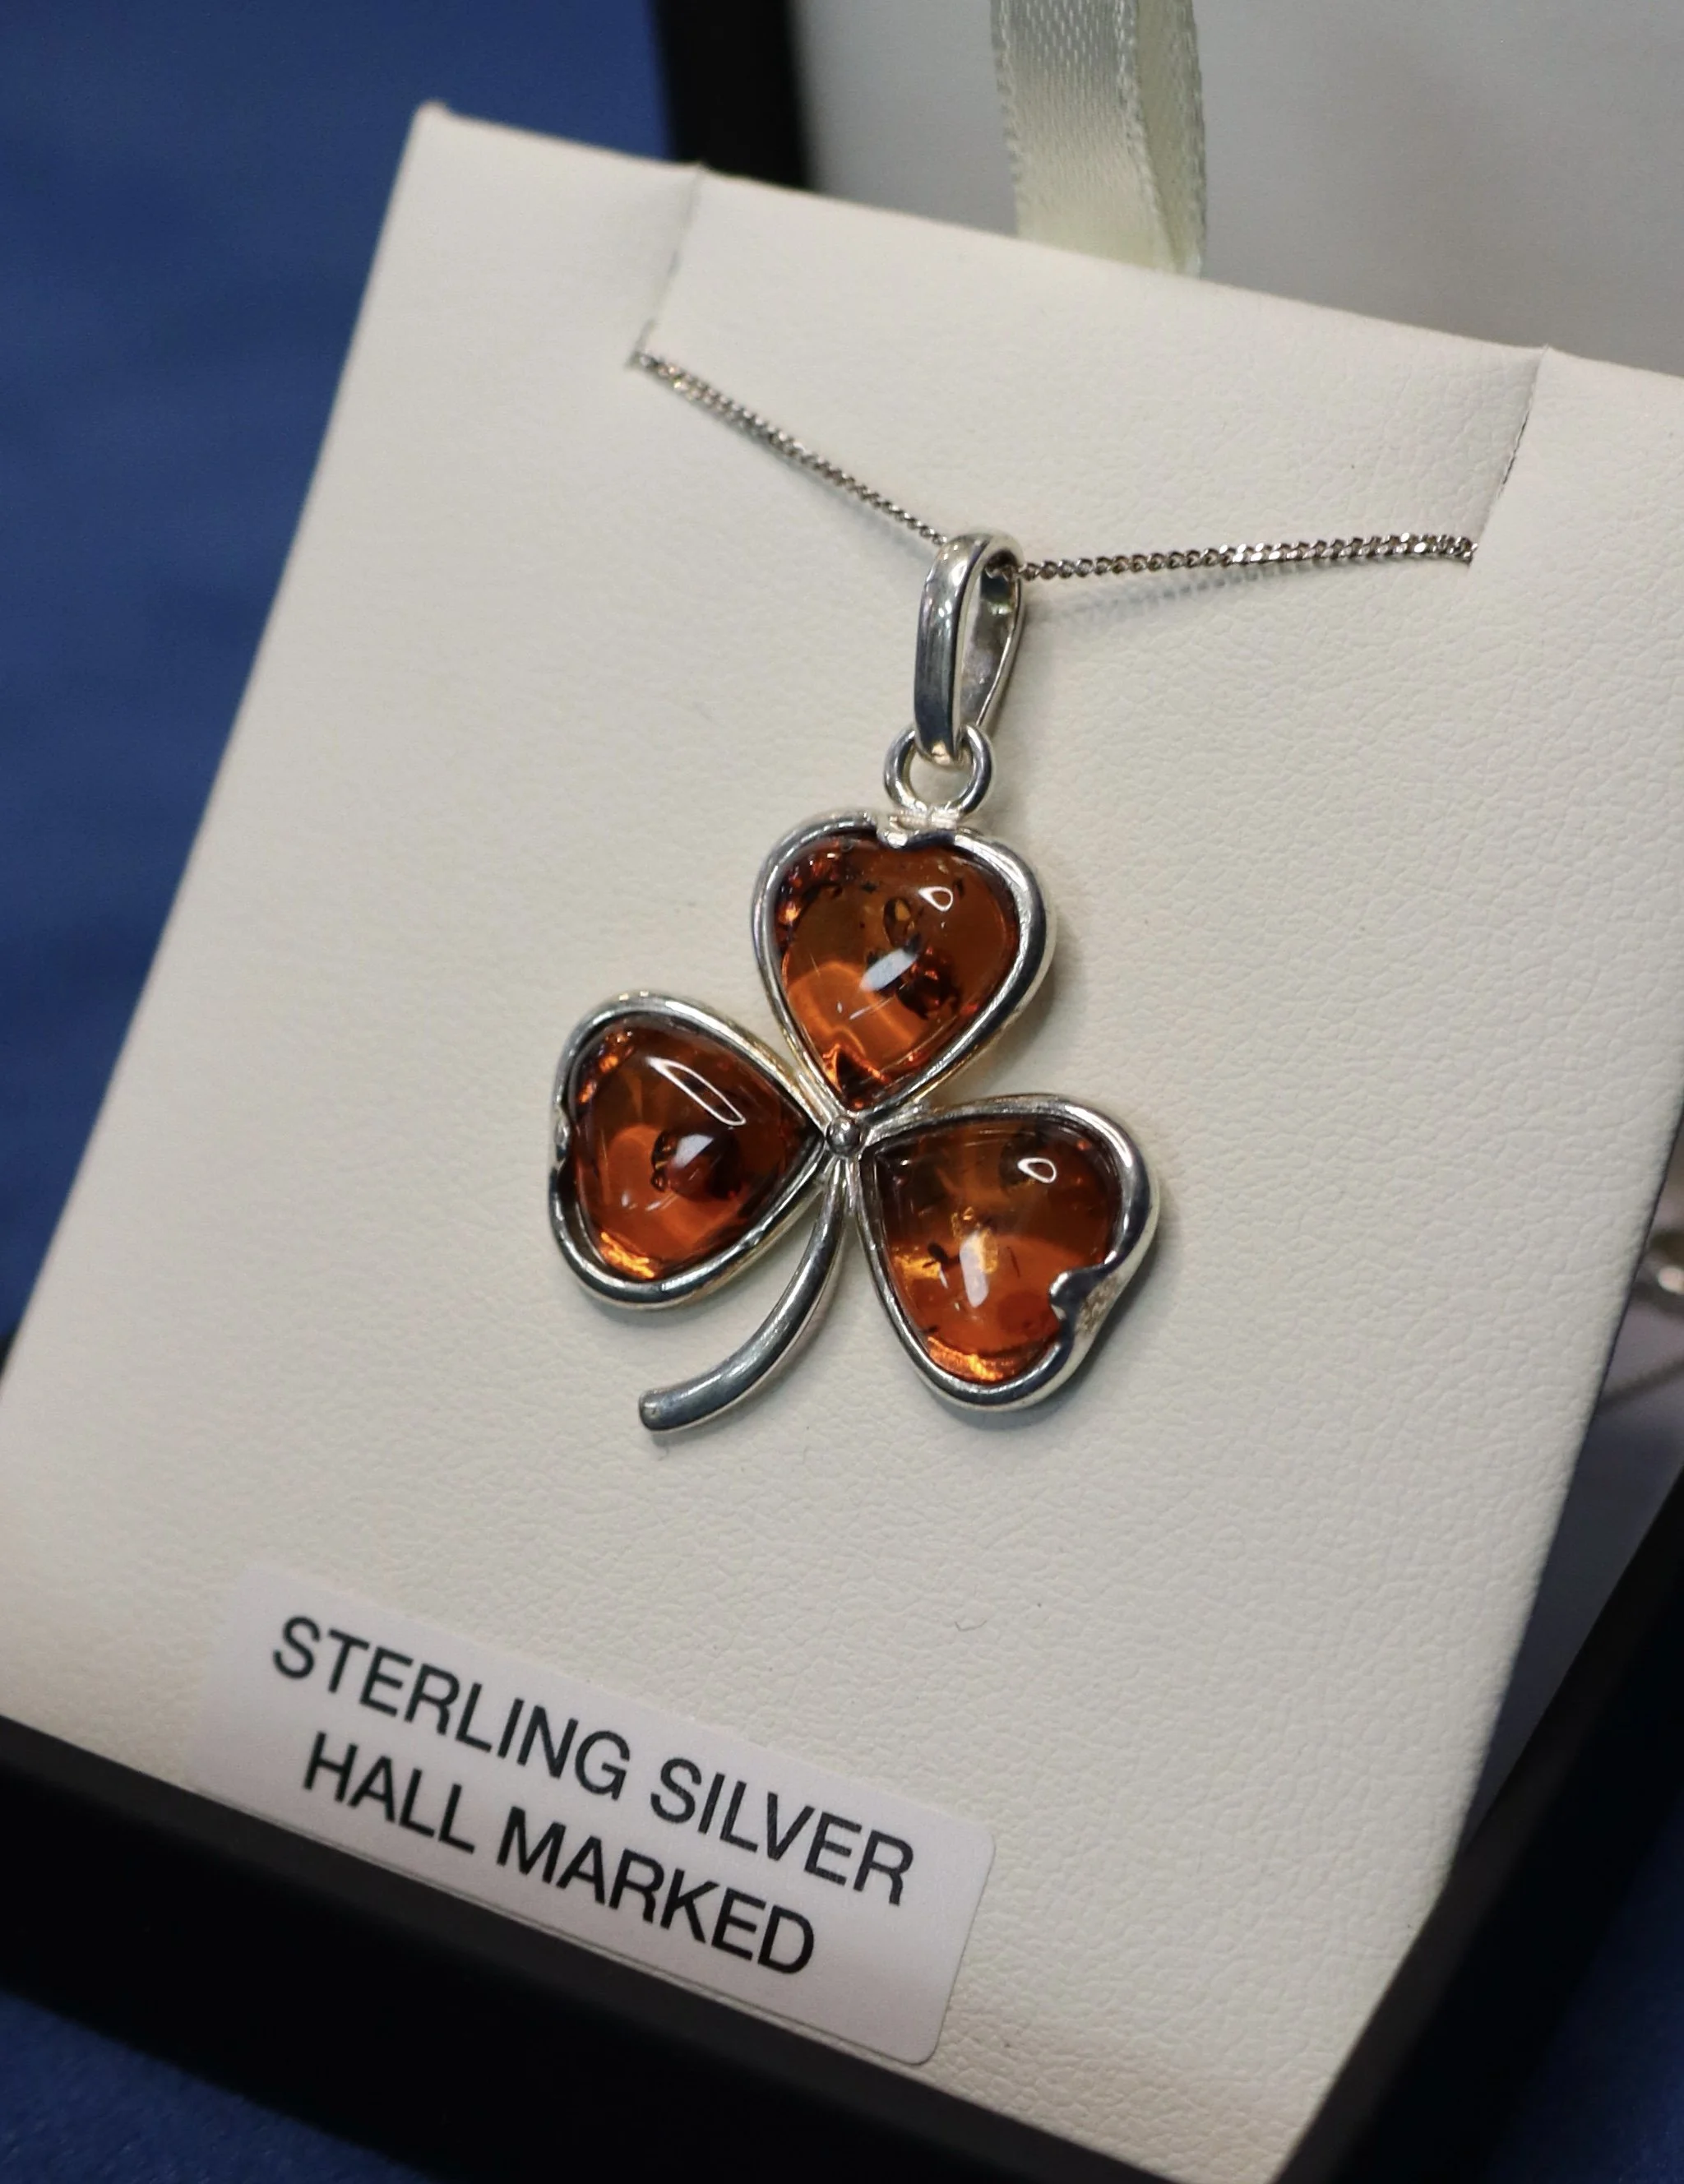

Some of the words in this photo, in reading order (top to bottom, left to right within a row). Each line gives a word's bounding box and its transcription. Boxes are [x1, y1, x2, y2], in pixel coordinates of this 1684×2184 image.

[271, 1615, 632, 1802] STERLING
[650, 1756, 915, 1908] SILVER
[301, 1730, 477, 1856] HALL
[495, 1805, 816, 1977] MARKED
